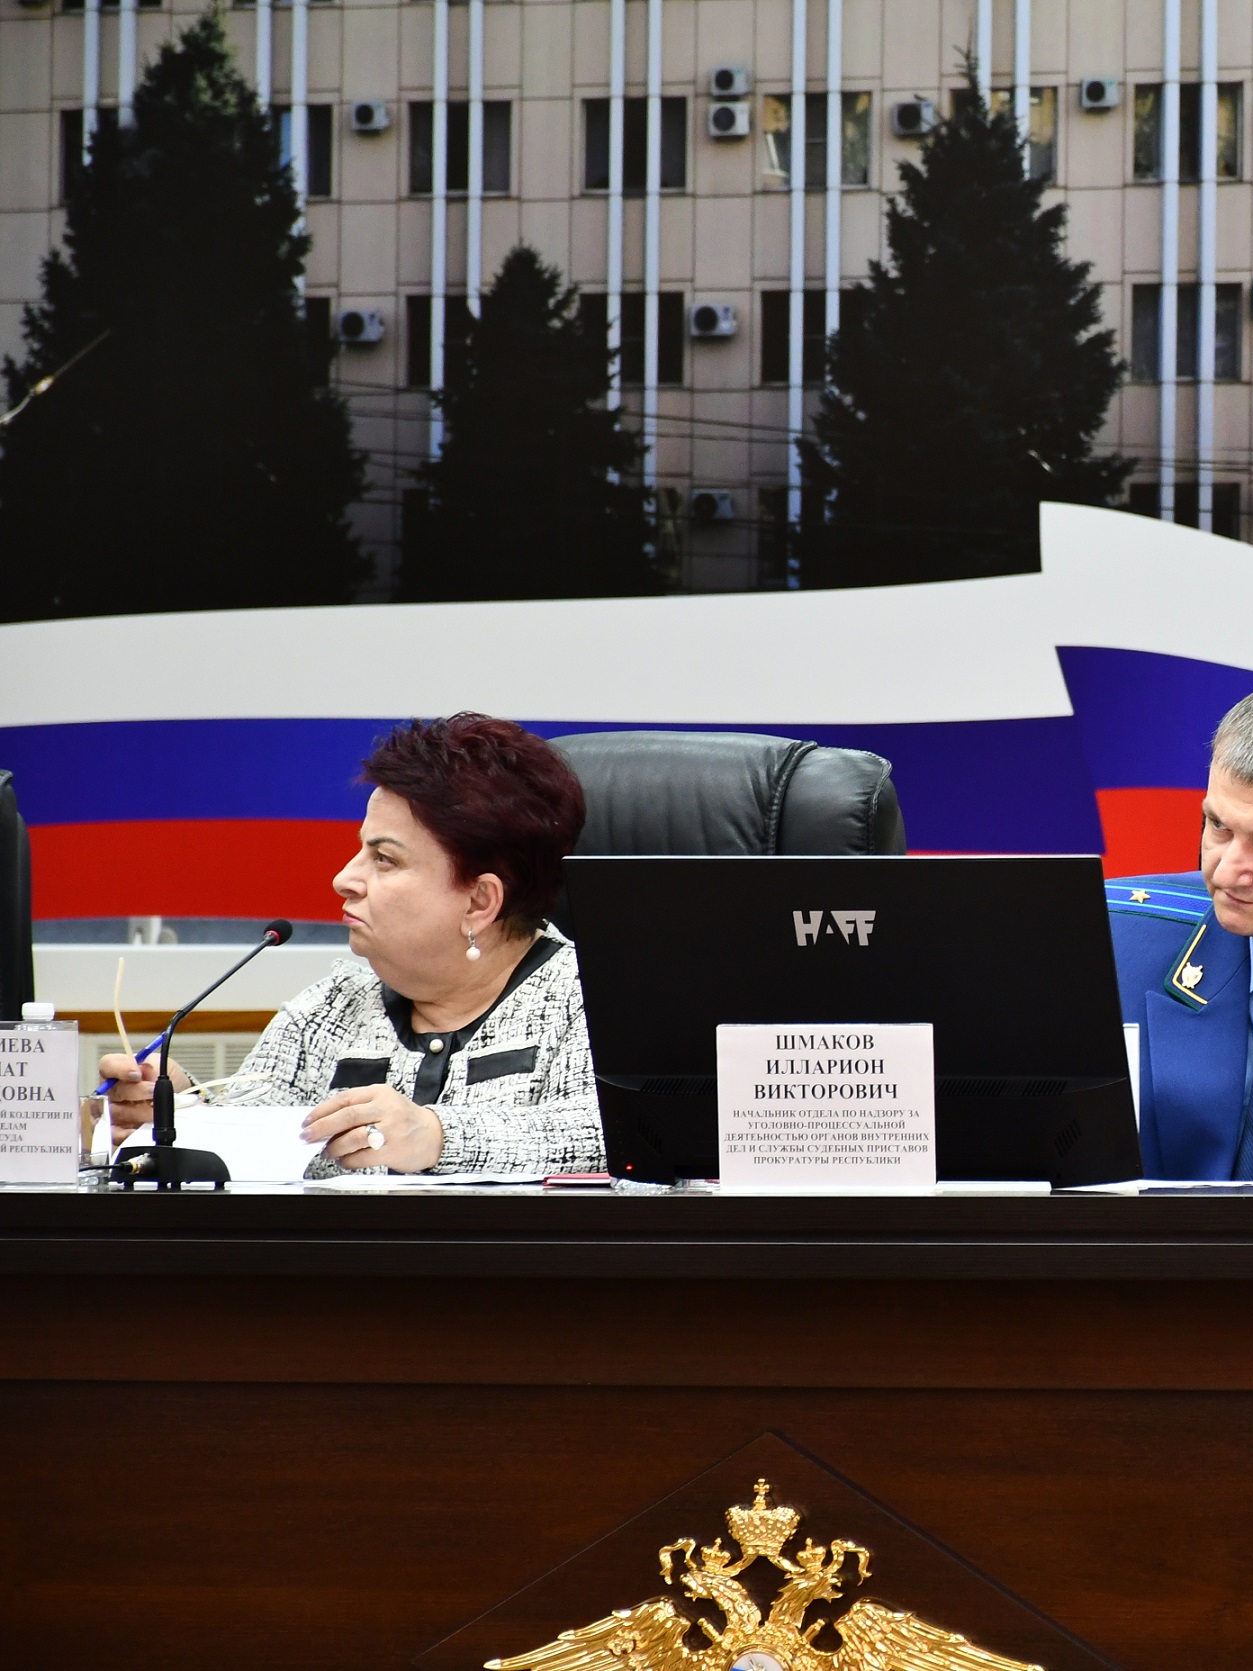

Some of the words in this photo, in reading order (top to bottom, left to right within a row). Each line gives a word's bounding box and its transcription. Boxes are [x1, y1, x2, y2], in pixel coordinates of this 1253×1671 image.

[793, 910, 877, 947] HAFF
[776, 1034, 875, 1051] ШМАКОВ
[766, 1059, 884, 1075] ИЛЛАРИОН
[754, 1083, 898, 1100] ВИКТОРОВИЧ
[9, 1110, 61, 1120] КОЛЛЕГИИ
[732, 1109, 797, 1118] НАЧАЛЬНИК
[798, 1109, 840, 1119] ОТДЕЛА
[842, 1109, 857, 1118] ПО
[859, 1109, 905, 1119] НАДЗОРУ
[908, 1109, 920, 1118] ЗА
[747, 1119, 906, 1130] УГОЛОВНО-ПРОЦЕССУАЛЬНОЙ
[810, 1132, 859, 1142] ОРГАНОВ
[860, 1132, 930, 1142] ВНУТРЕННИХ
[9, 1144, 73, 1154] РЕСПУБЛИКИ
[725, 1144, 746, 1154] ДЕЛ
[749, 1144, 756, 1153] И
[758, 1144, 805, 1153] СЛУЖБЫ
[806, 1144, 864, 1154] СУДЕБНЫХ
[866, 1144, 929, 1153] ПРИСТАВОВ
[753, 1156, 830, 1165] ПРОКУРАТУРЫ
[832, 1156, 901, 1165] РЕСПУБЛИКИ
